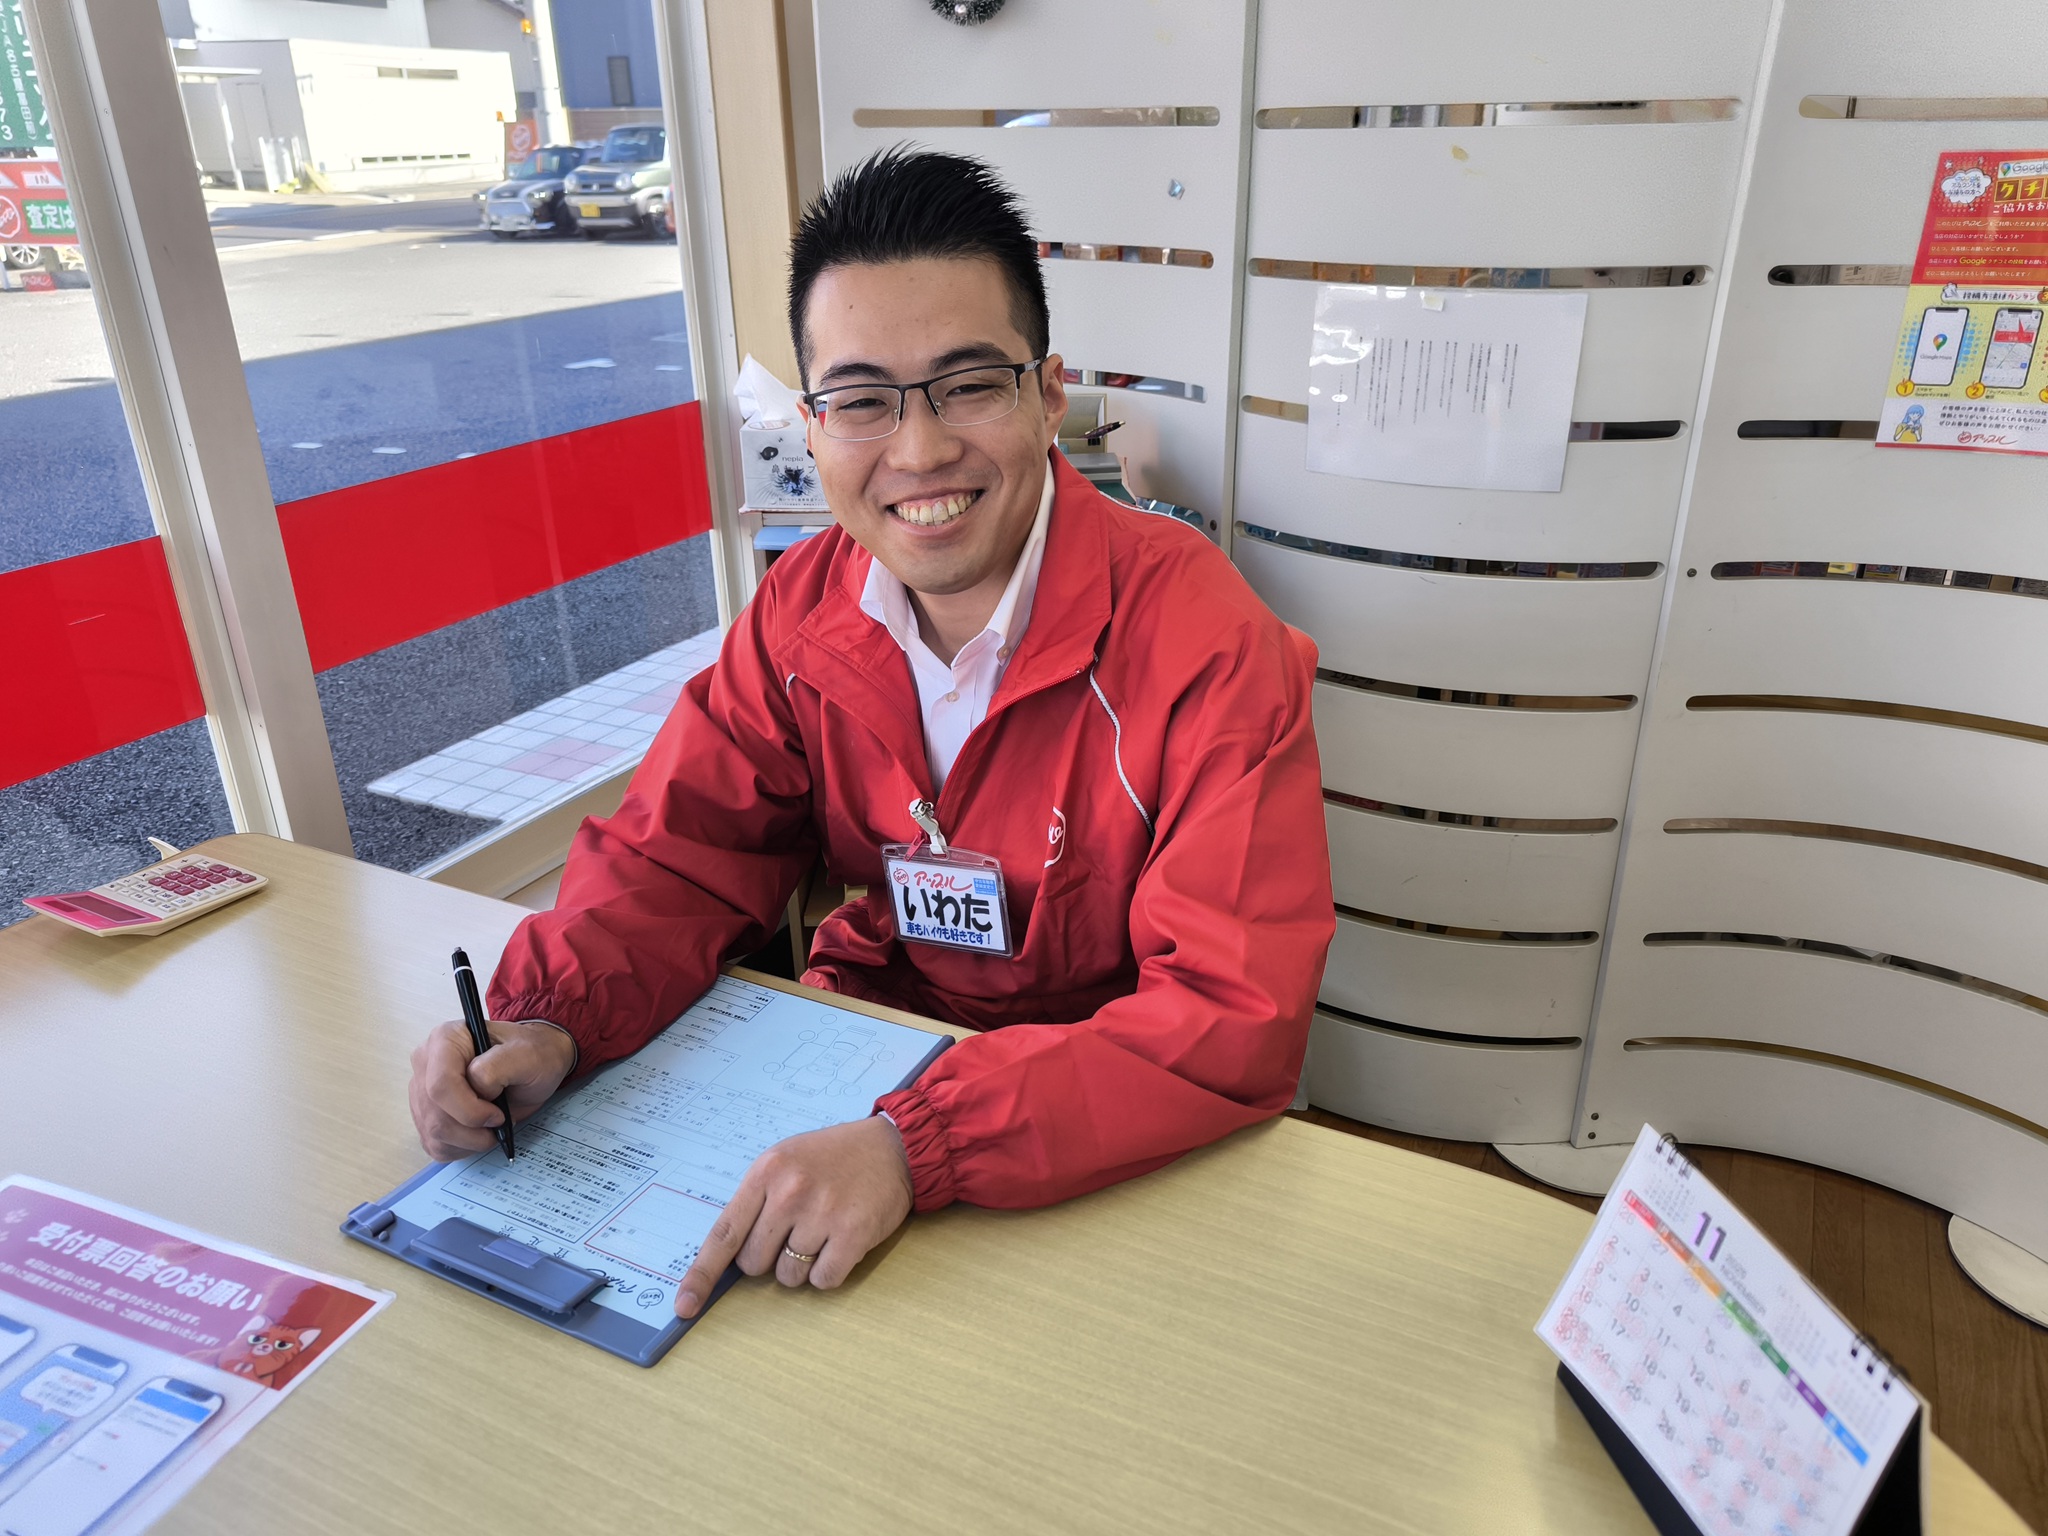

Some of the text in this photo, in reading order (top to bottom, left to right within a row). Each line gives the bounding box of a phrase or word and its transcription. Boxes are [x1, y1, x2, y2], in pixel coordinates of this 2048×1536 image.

[35, 175, 49, 184] IN
[1993, 202, 2048, 213] ご協力をお
[1960, 257, 1987, 266] Google
[904, 886, 993, 932] いわた
[1689, 1211, 1727, 1262] 11
[27, 1222, 263, 1311] 受付票回答のお願い
